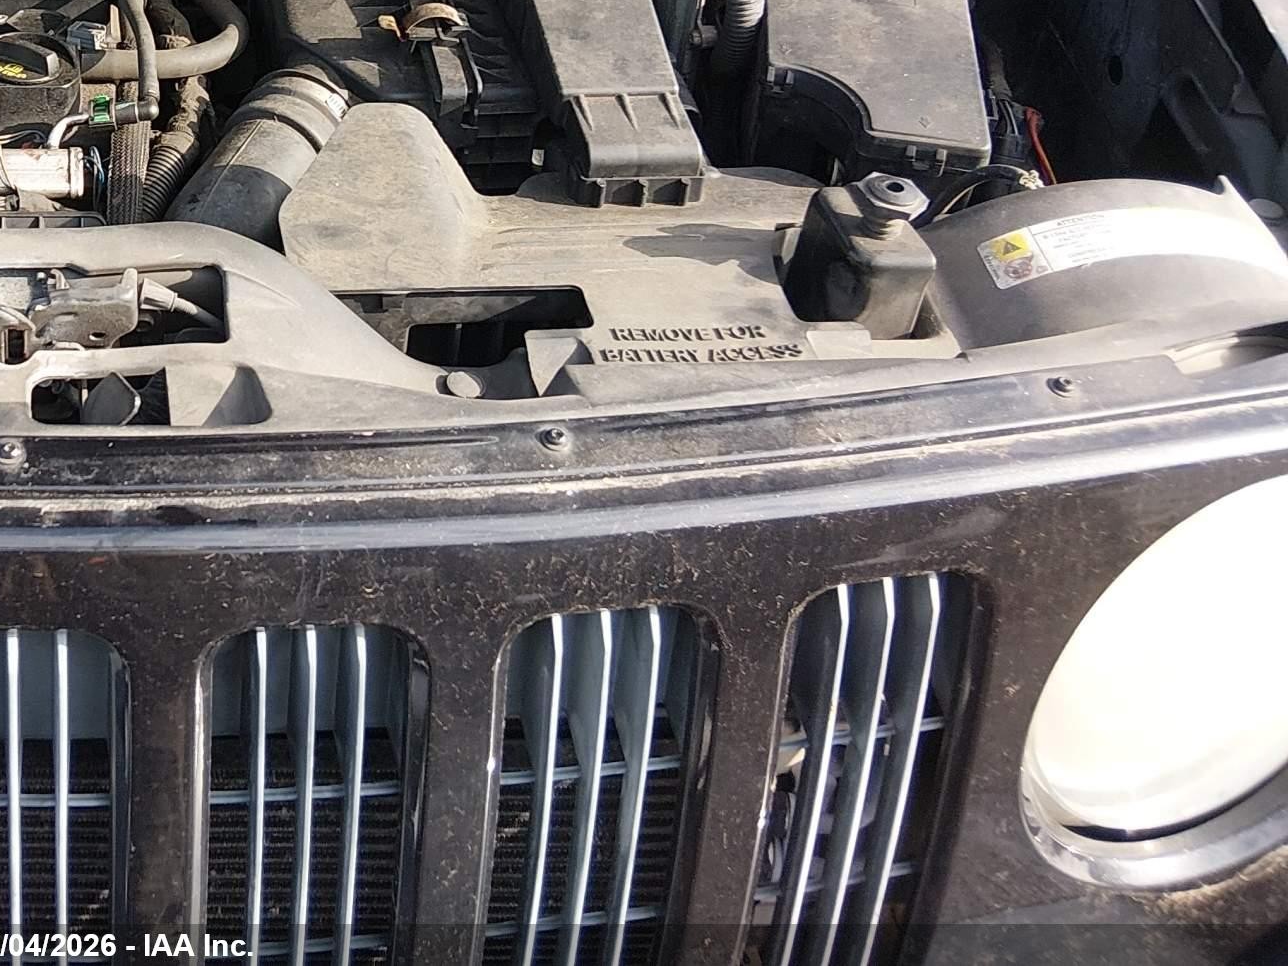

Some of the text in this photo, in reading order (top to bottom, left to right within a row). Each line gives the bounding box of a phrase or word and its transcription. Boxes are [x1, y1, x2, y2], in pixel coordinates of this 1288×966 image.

[609, 325, 766, 342] REMOVE FOR
[599, 344, 803, 363] BATTERY ACCESS
